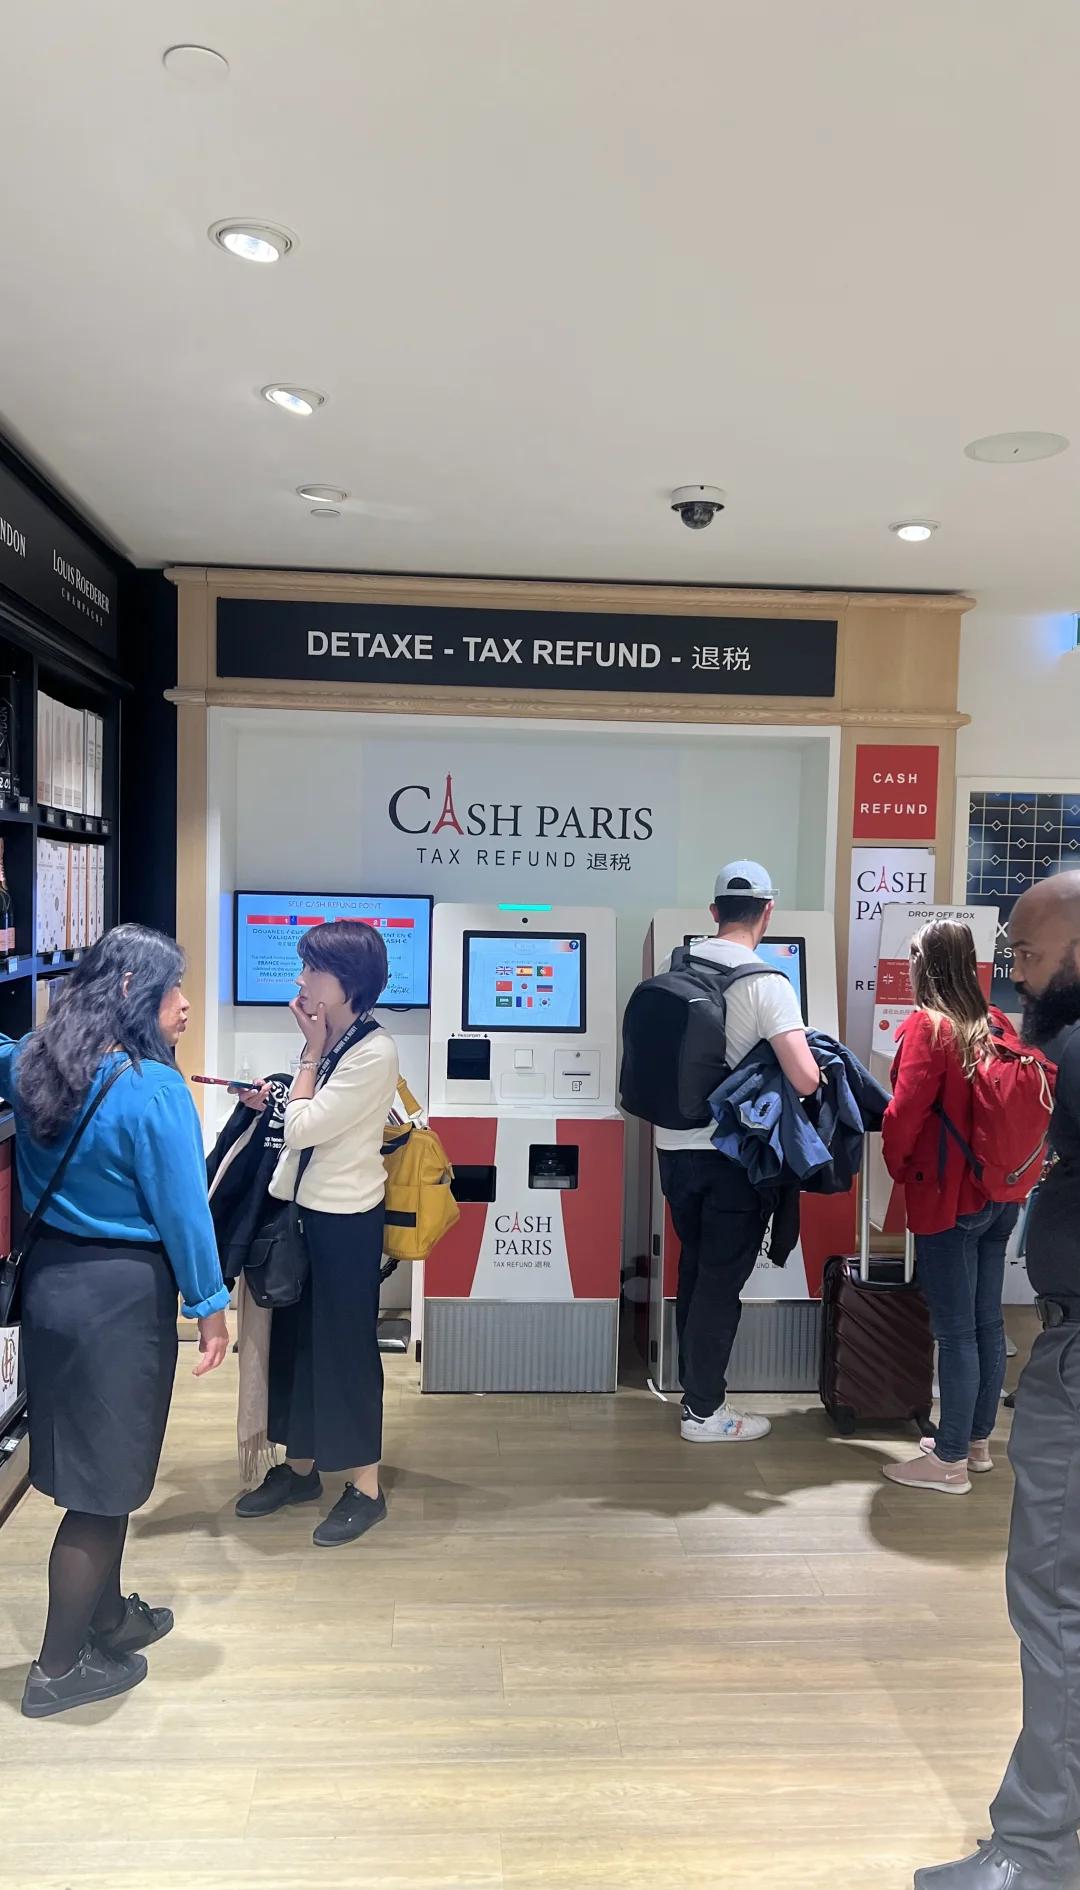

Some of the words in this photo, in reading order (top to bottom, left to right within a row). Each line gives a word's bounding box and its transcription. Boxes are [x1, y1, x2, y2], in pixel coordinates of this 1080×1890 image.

[53, 549, 75, 585] LOUIS
[75, 568, 110, 614] ROEDERER
[307, 630, 433, 660] DETAXE
[462, 636, 523, 665] TAX
[532, 639, 661, 668] REFUND
[691, 645, 751, 671] 退税
[872, 773, 918, 784] CASH
[388, 771, 523, 837] CASH
[535, 805, 653, 841] PARIS
[860, 803, 928, 815] REFUND
[416, 848, 461, 865] TAX
[476, 850, 576, 867] REFUND
[586, 852, 632, 871] 退税
[857, 866, 927, 893] CASH
[908, 910, 935, 918] DROP
[936, 911, 955, 919] OFF
[494, 1211, 552, 1233] CASH
[495, 1239, 552, 1256] PARIS
